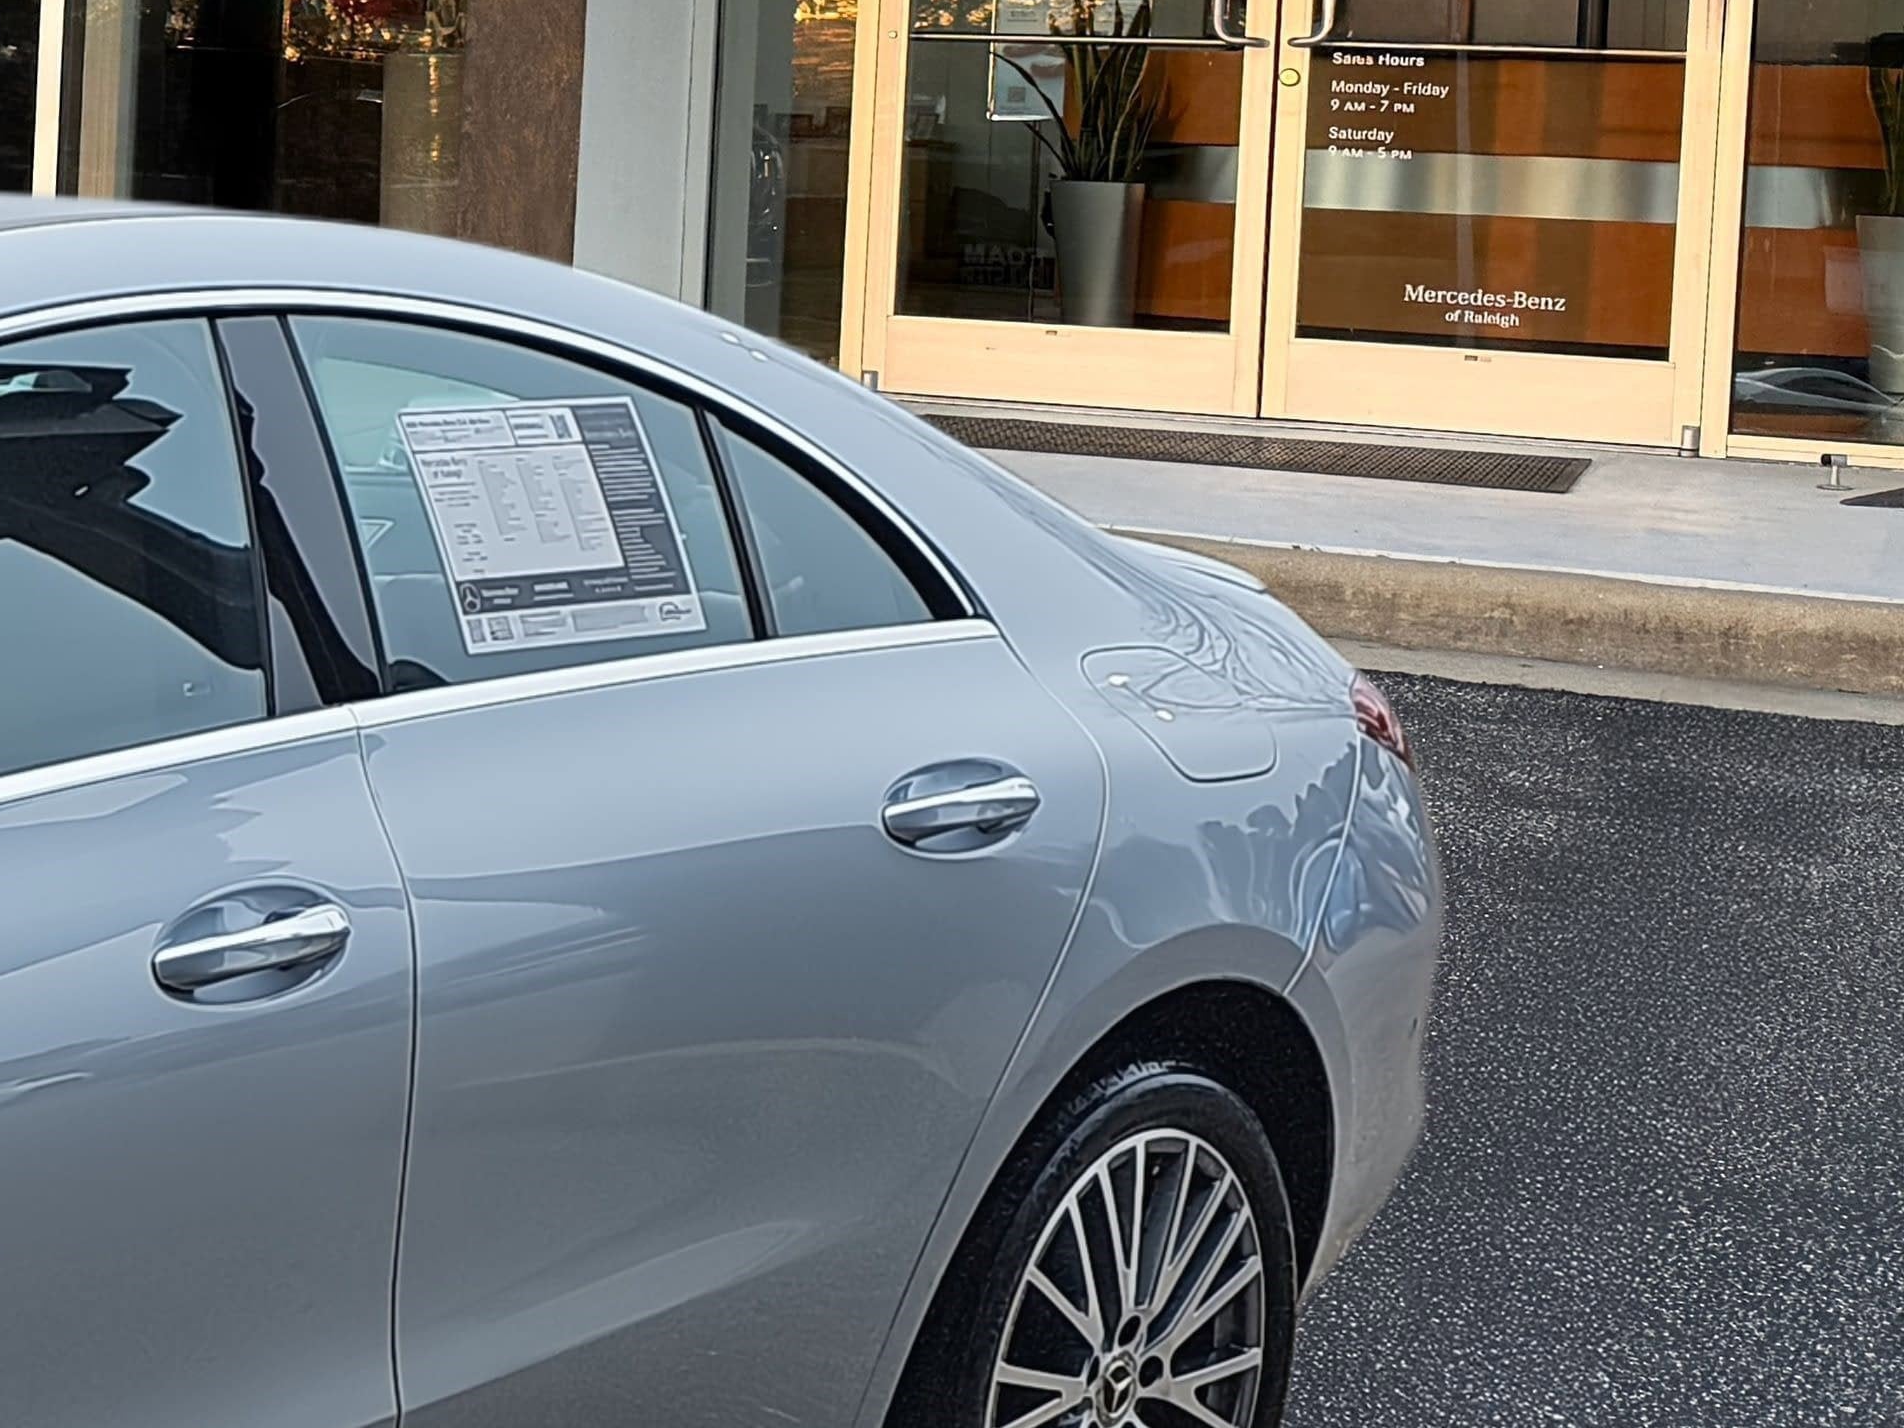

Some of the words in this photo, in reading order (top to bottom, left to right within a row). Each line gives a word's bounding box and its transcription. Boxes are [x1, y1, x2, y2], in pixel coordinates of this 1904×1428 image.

[1378, 53, 1425, 67] Hours
[1331, 80, 1390, 97] Monday
[1403, 82, 1449, 98] Friday
[1330, 98, 1340, 111] 9
[1343, 102, 1366, 112] AM
[1379, 100, 1389, 112] 7
[1393, 103, 1415, 113] PM
[1328, 126, 1394, 144] Saturday
[1377, 147, 1387, 159] 5
[1391, 150, 1412, 160] PM
[1403, 284, 1566, 312] Mercedes-Benz
[1444, 310, 1462, 323] of
[1464, 311, 1520, 329] Raleigh
